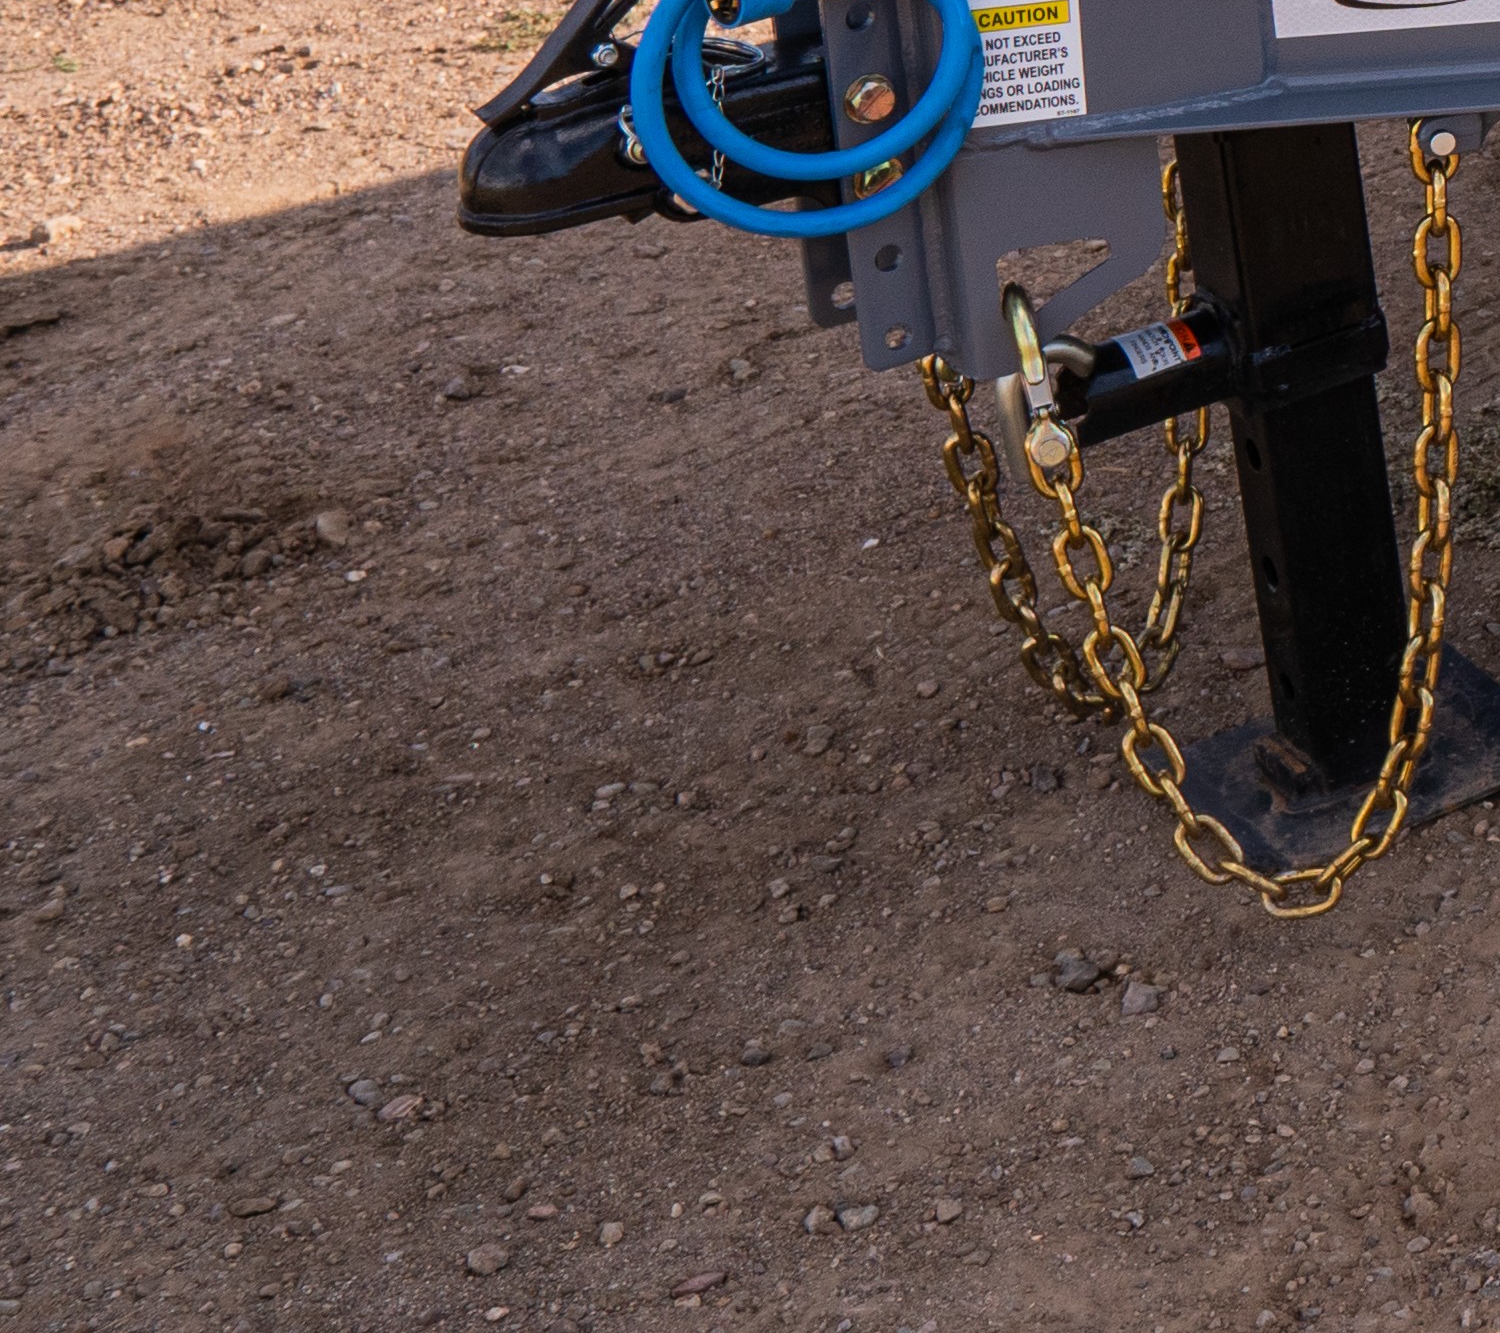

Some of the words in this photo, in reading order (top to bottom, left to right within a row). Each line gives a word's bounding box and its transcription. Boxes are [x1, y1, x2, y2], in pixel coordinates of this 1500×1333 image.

[978, 6, 1059, 28] CAUTION
[985, 37, 1010, 51] NOT
[1013, 31, 1061, 48] EXCEED
[984, 46, 1069, 68] UFACTURER'S
[983, 68, 1016, 84] HICLE
[1018, 63, 1065, 79] WEIGHT
[1007, 84, 1024, 96] OR
[1028, 77, 1080, 95] LOADING
